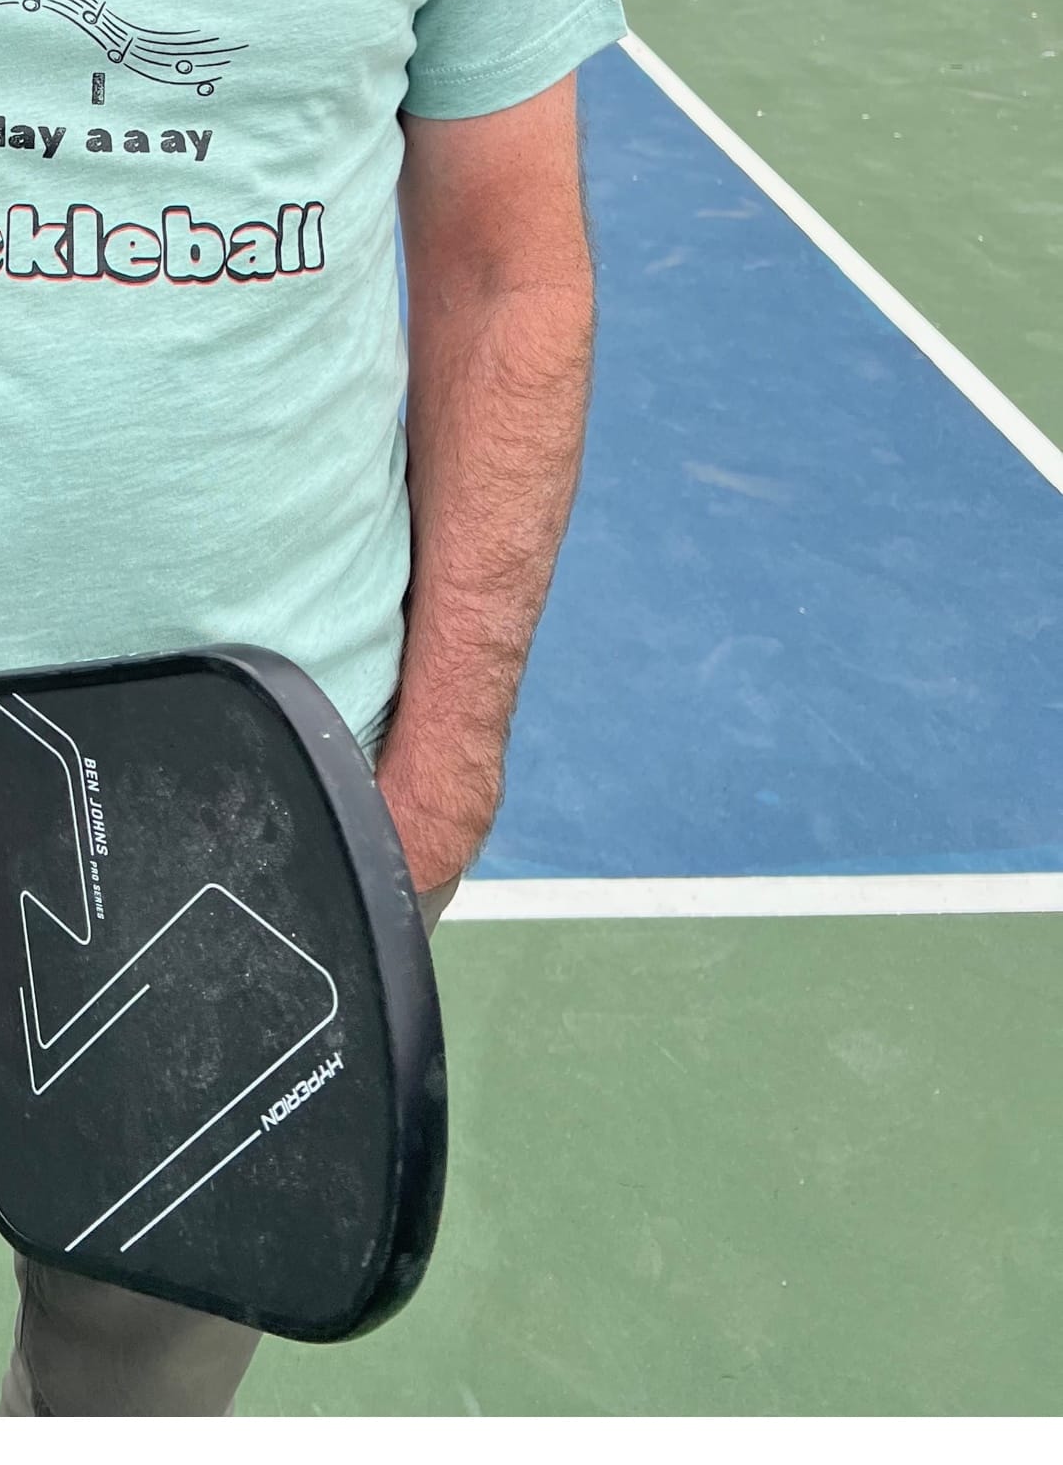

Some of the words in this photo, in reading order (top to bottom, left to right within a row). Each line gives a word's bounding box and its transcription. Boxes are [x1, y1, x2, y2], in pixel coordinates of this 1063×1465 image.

[83, 757, 100, 792] BEN
[89, 797, 108, 857] JOHNS
[89, 860, 100, 881] PRO
[92, 884, 105, 920] SERIES
[261, 1051, 345, 1134] HYPERION
